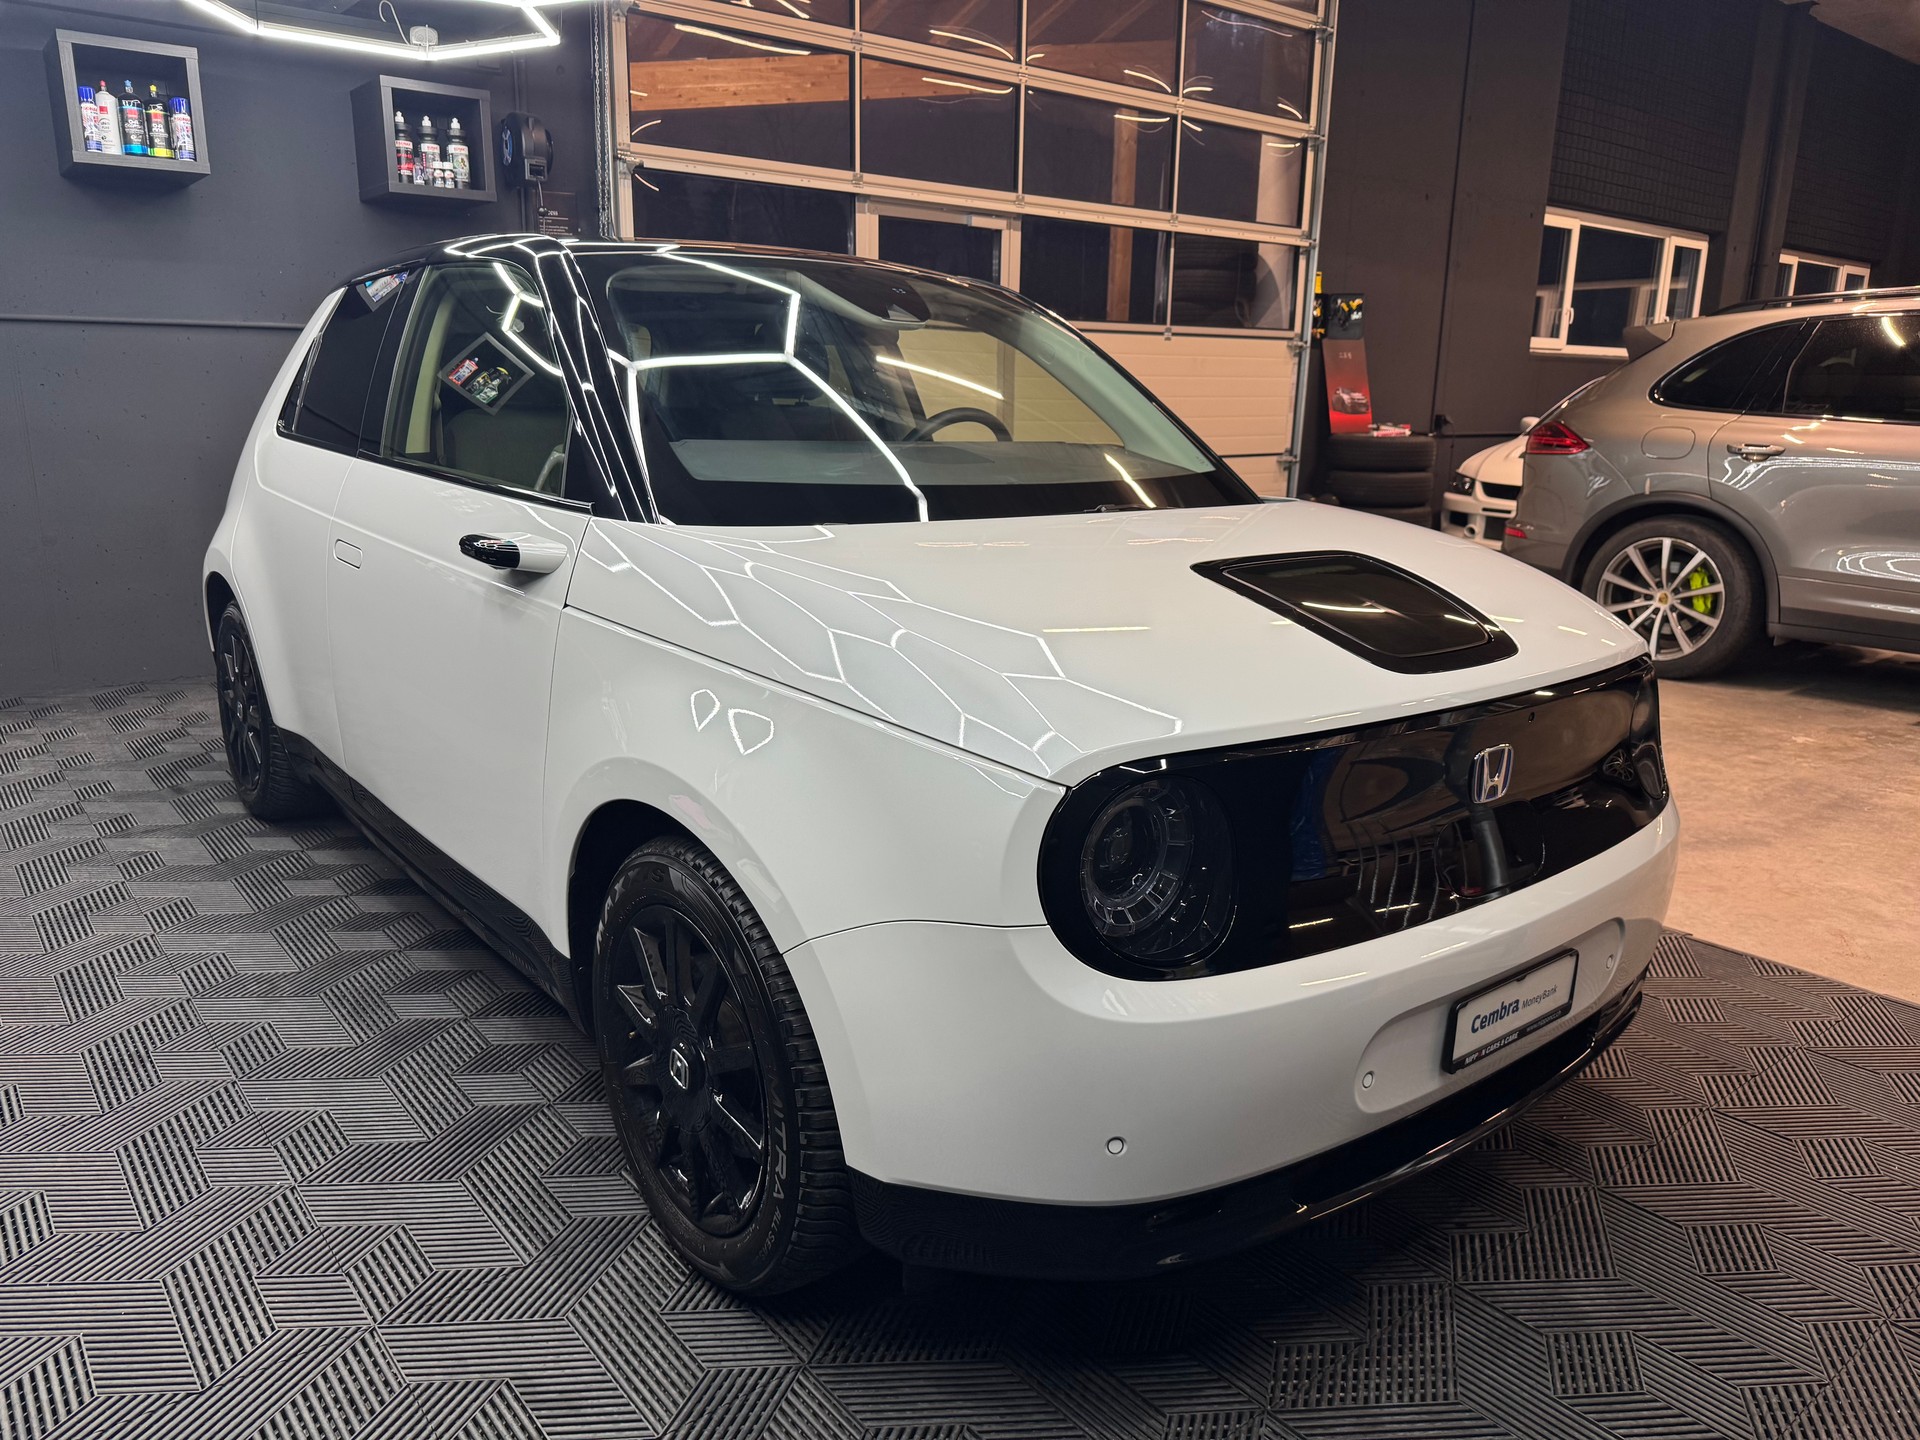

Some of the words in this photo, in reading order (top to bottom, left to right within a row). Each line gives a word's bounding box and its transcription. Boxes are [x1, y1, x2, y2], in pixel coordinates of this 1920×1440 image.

[595, 867, 666, 956] MAXXS
[1471, 998, 1520, 1034] Cembra
[1521, 984, 1558, 1010] MoneyBank
